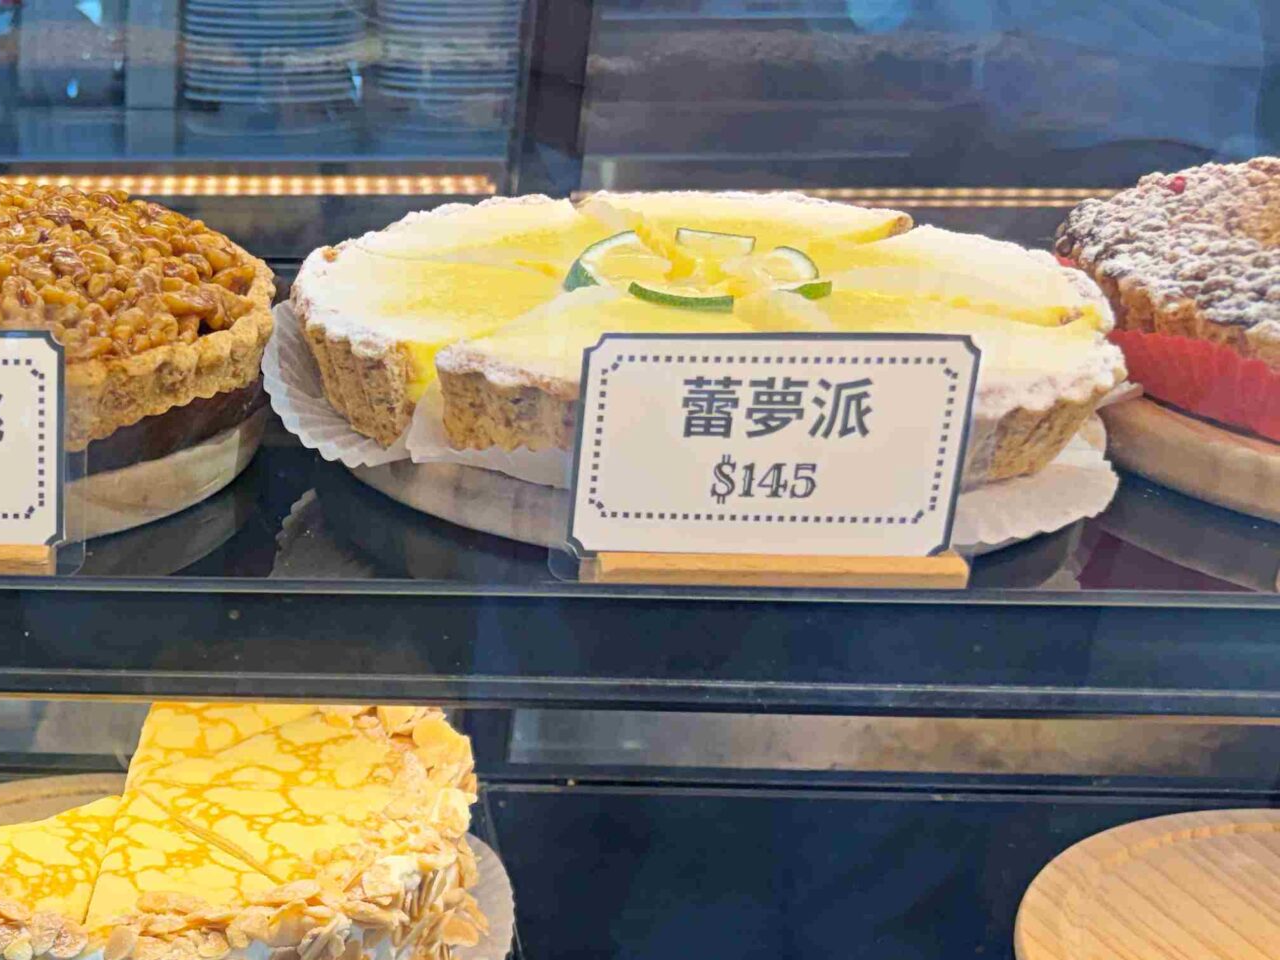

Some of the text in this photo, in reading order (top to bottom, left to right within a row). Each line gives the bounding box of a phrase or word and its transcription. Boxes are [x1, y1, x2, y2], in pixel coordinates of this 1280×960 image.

[682, 376, 873, 439] 蕾夢派
[711, 455, 818, 504] $145
